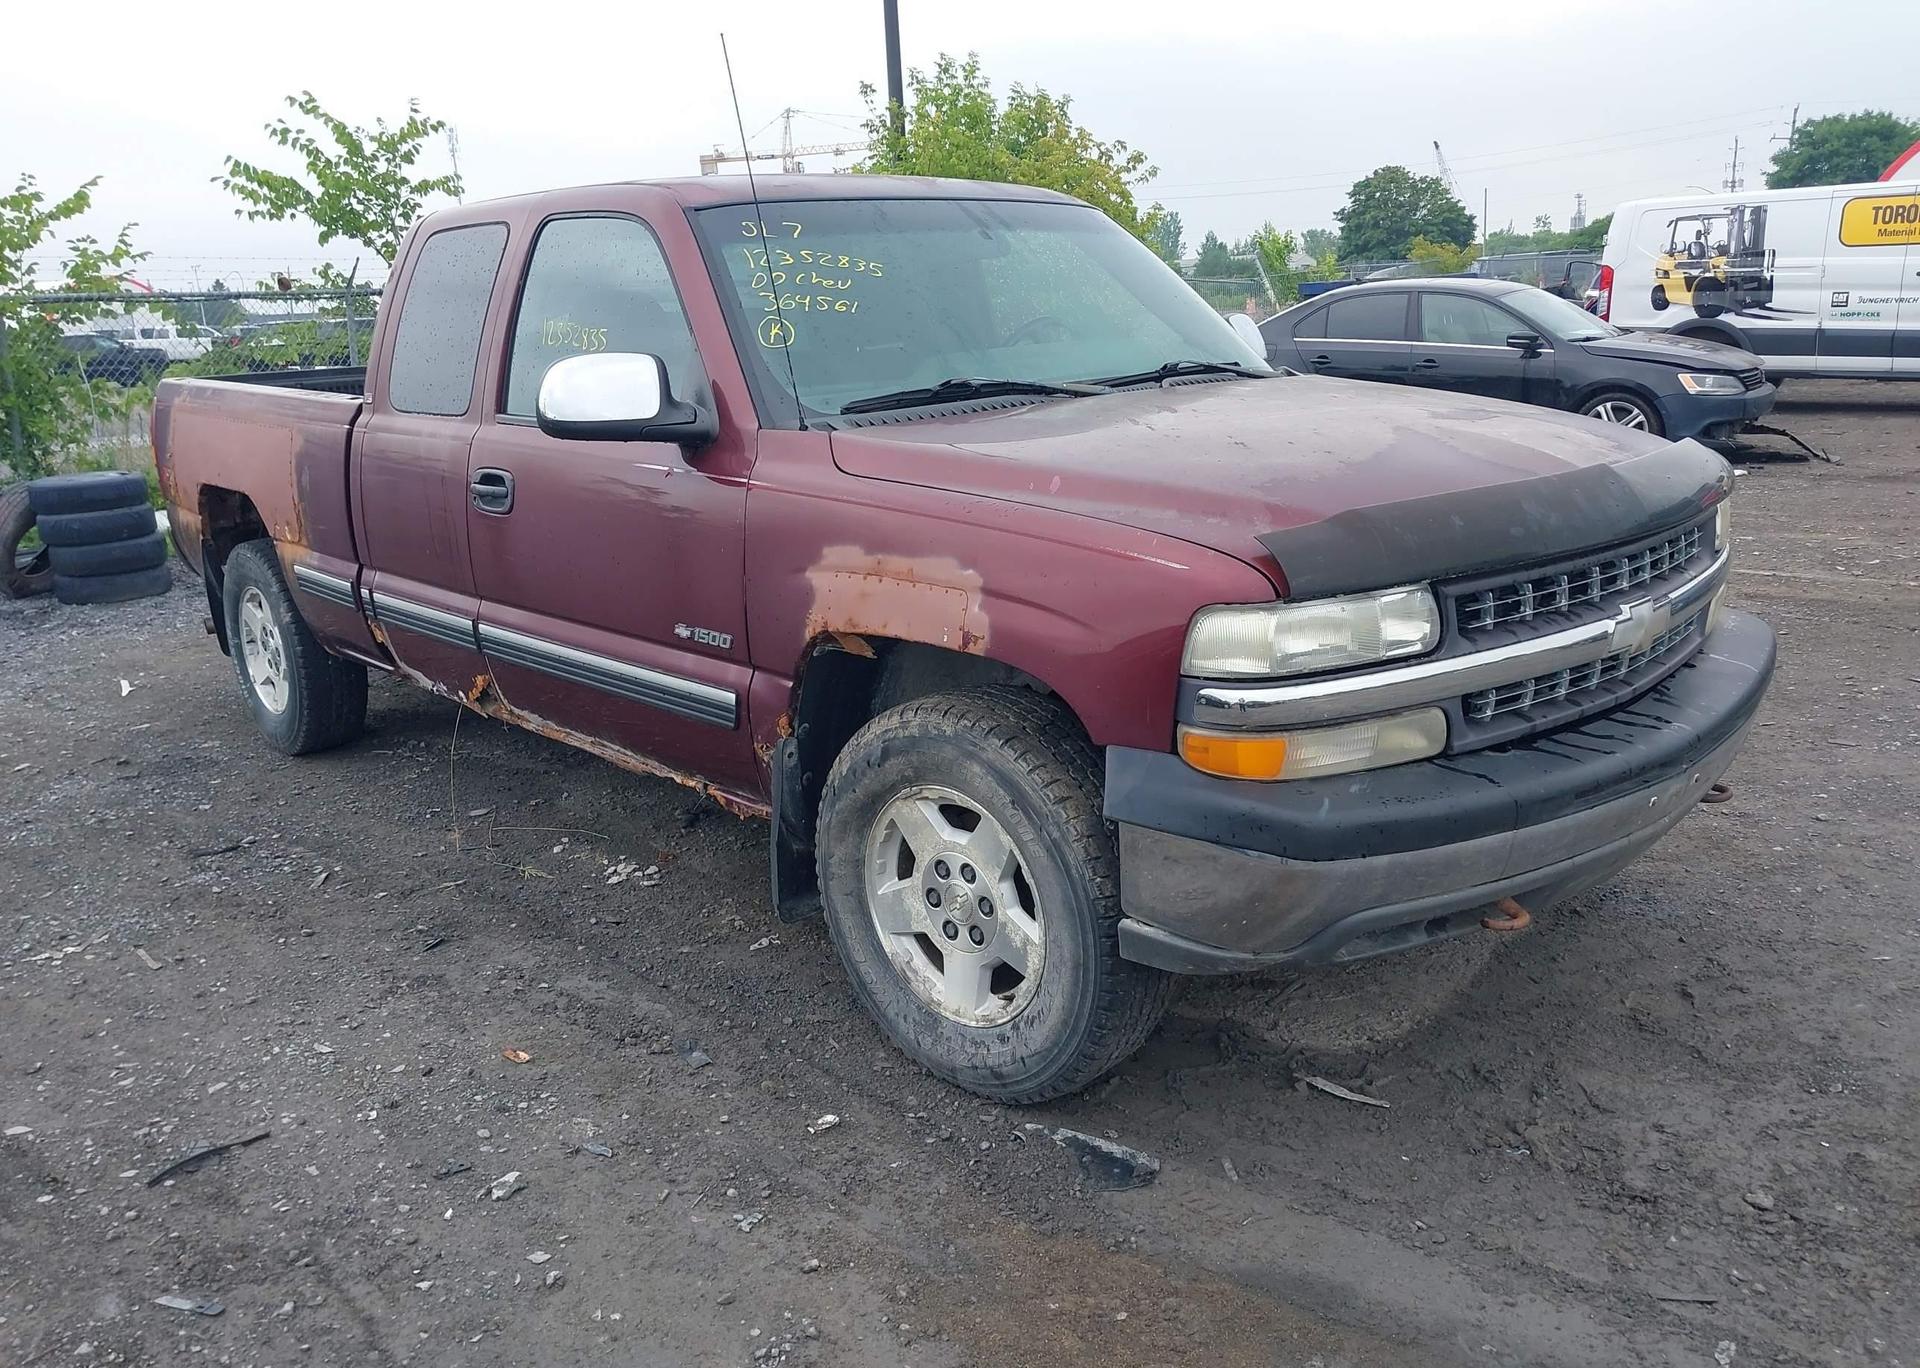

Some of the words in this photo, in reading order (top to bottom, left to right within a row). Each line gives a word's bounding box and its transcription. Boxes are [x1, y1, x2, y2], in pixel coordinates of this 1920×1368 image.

[1872, 203, 1920, 225] TORO
[782, 221, 802, 239] 7
[1877, 226, 1917, 238] Material
[743, 248, 884, 278] 12352835
[758, 292, 858, 314] 364561
[542, 317, 608, 351] 12352835
[693, 626, 734, 650] 1500
